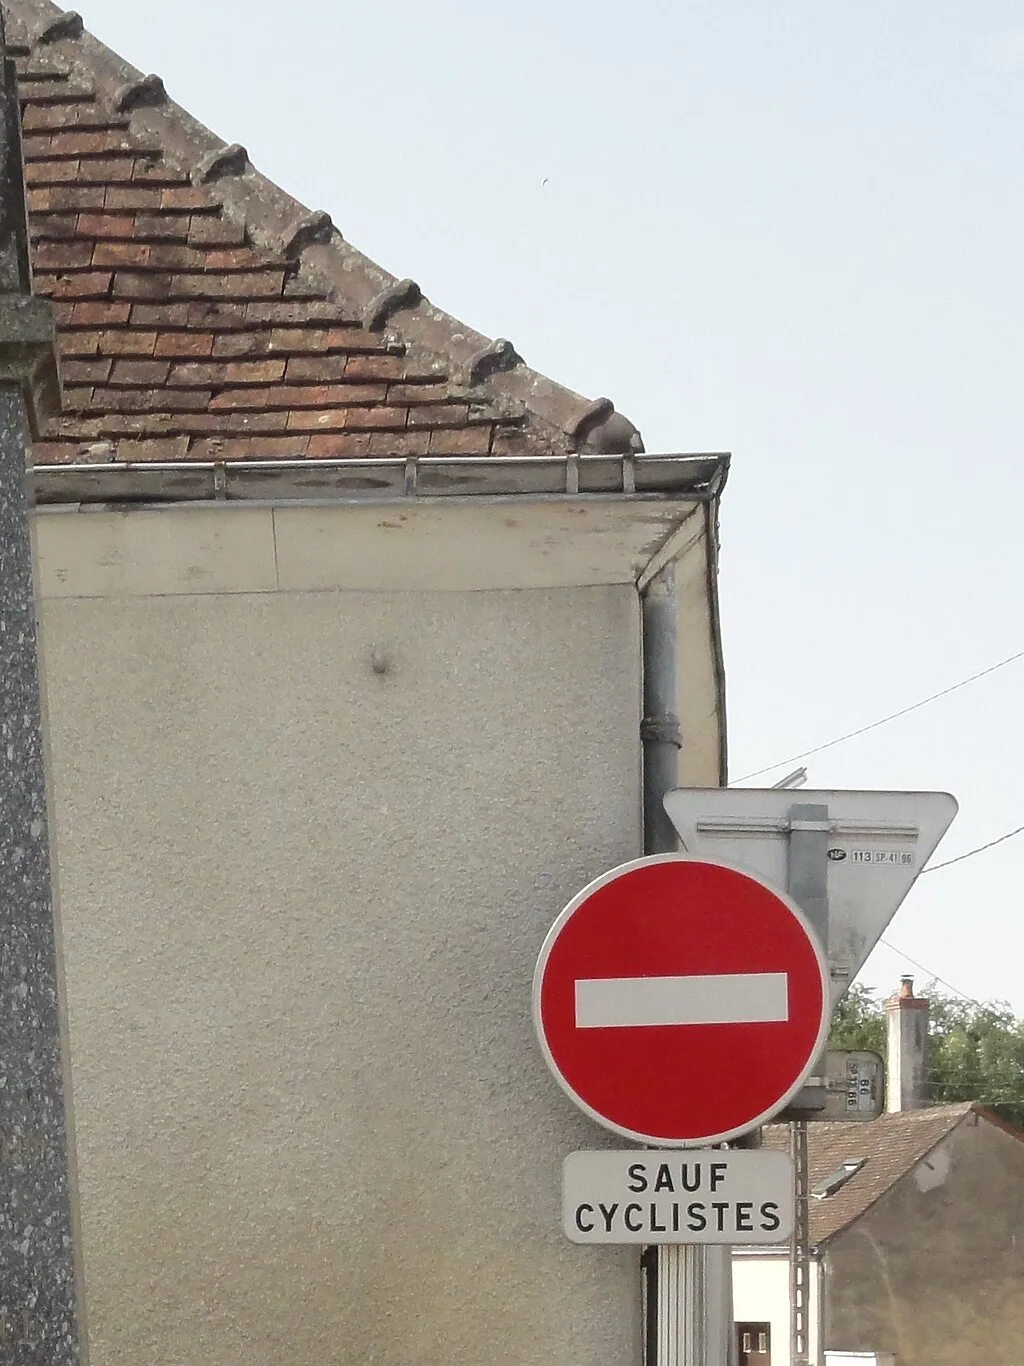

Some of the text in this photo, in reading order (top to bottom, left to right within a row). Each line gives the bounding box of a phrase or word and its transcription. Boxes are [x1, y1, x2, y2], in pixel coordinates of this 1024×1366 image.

[853, 852, 872, 862] 113
[628, 1163, 728, 1193] SAUF
[575, 1202, 780, 1232] CYCLISTES
